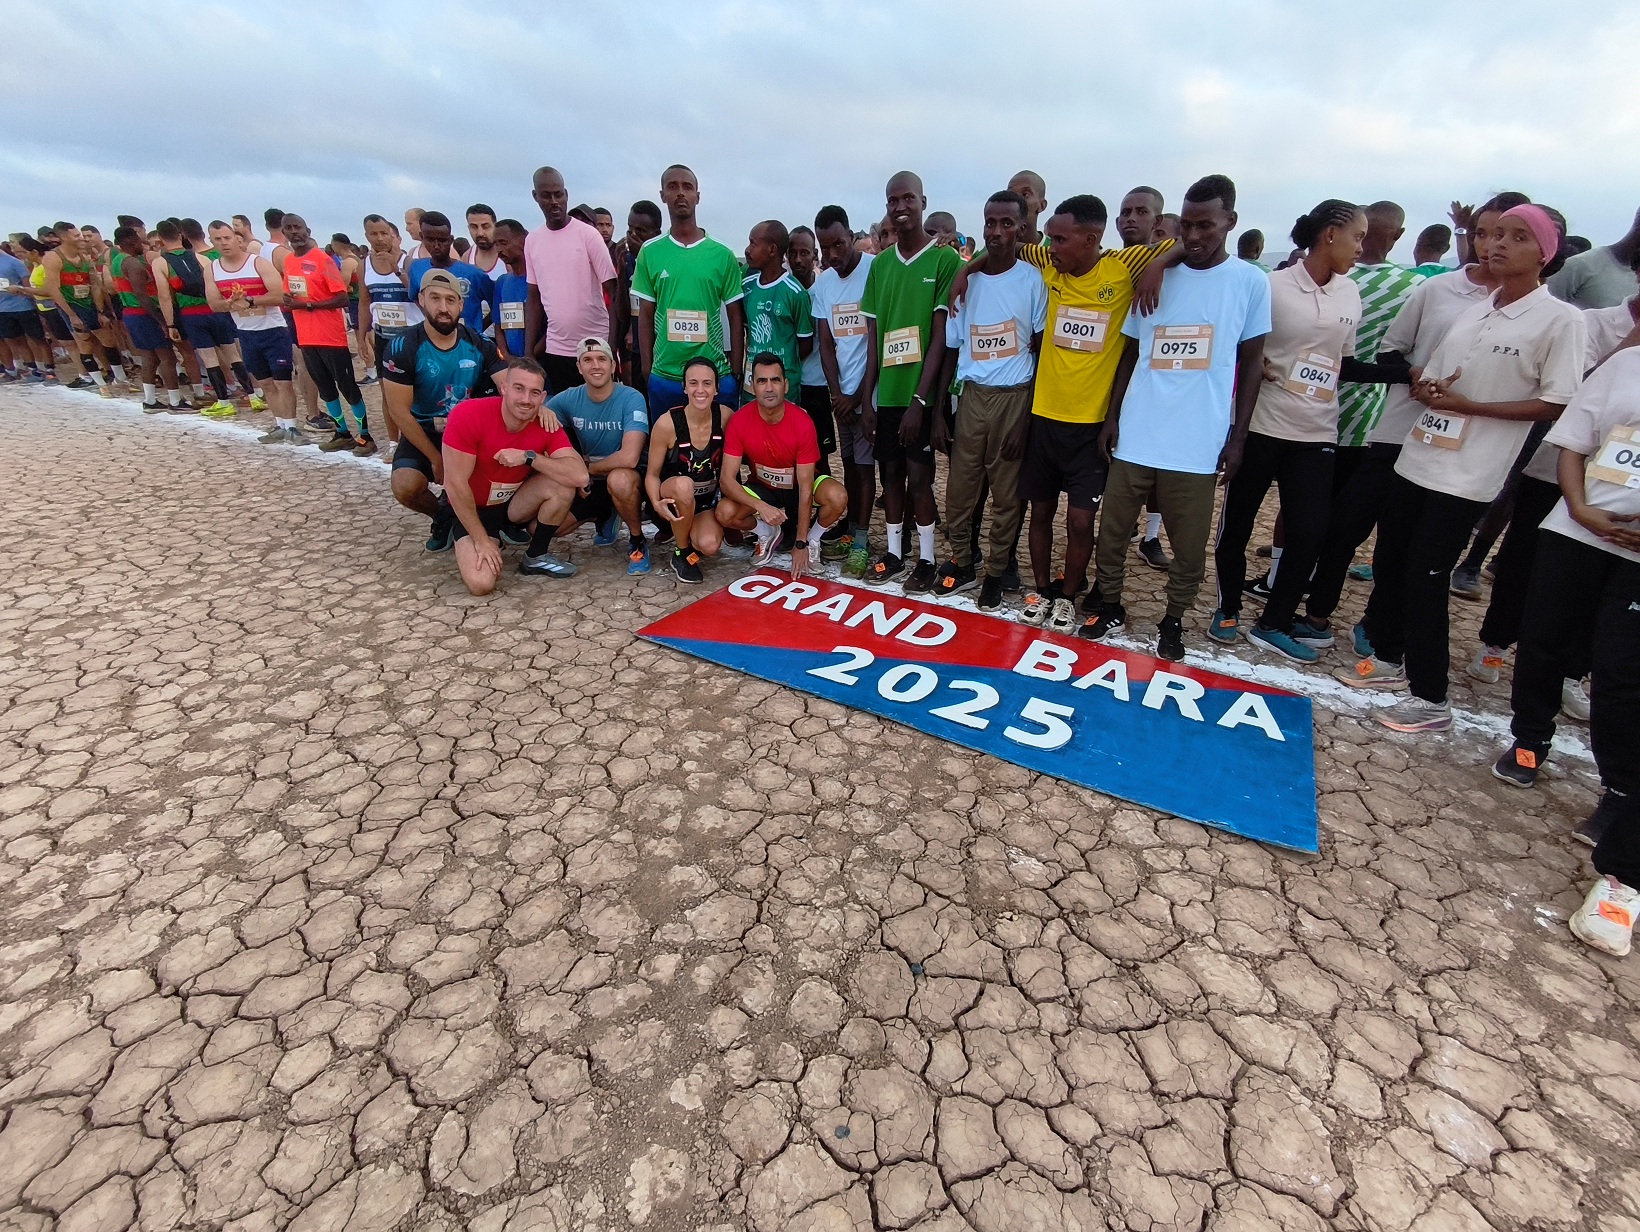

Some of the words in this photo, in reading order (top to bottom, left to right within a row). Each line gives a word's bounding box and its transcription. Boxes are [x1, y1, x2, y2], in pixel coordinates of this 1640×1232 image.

[1098, 285, 1114, 299] BVB
[674, 321, 700, 332] 0828
[838, 315, 859, 326] 0972
[1063, 322, 1095, 337] 0801
[888, 341, 910, 354] 0837
[977, 336, 1006, 349] 0976
[1161, 342, 1197, 355] 0975
[1492, 345, 1520, 357] P.F.A
[1299, 367, 1331, 384] 0847
[763, 472, 784, 483] 0781
[728, 574, 957, 646] GRAND
[1012, 639, 1287, 742] BARA
[805, 645, 1076, 752] 2025
